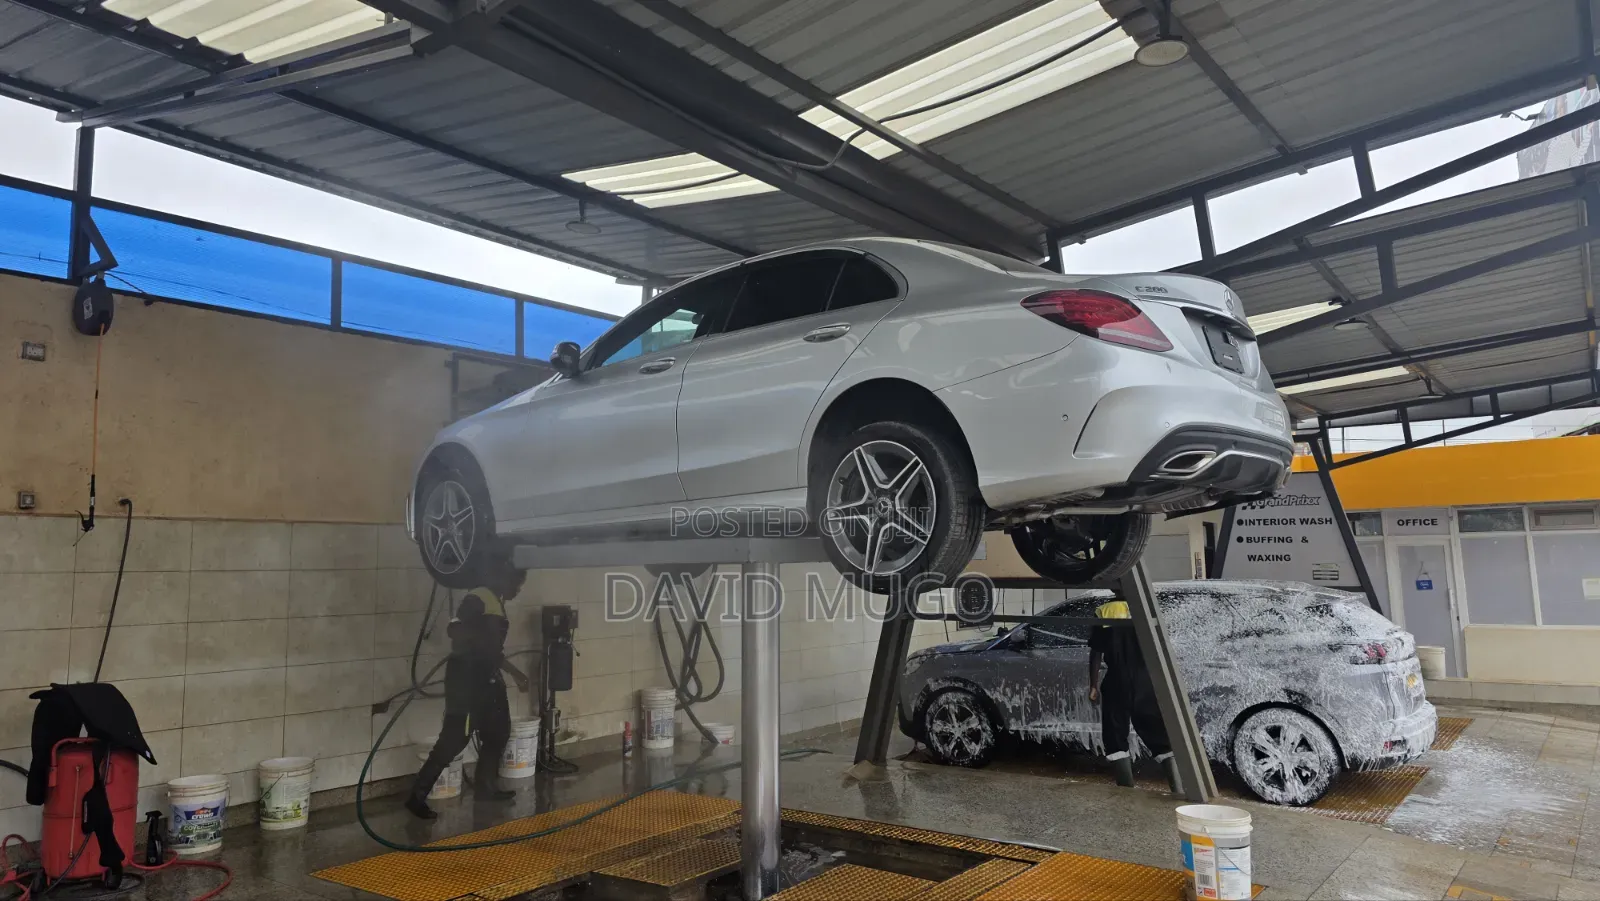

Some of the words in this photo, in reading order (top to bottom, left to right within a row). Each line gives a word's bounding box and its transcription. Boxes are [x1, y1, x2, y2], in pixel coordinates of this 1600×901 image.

[1245, 518, 1297, 526] INTERIOR
[1299, 517, 1333, 525] WASH
[1397, 518, 1438, 526] OFFICE
[1247, 554, 1291, 562] WAXING
